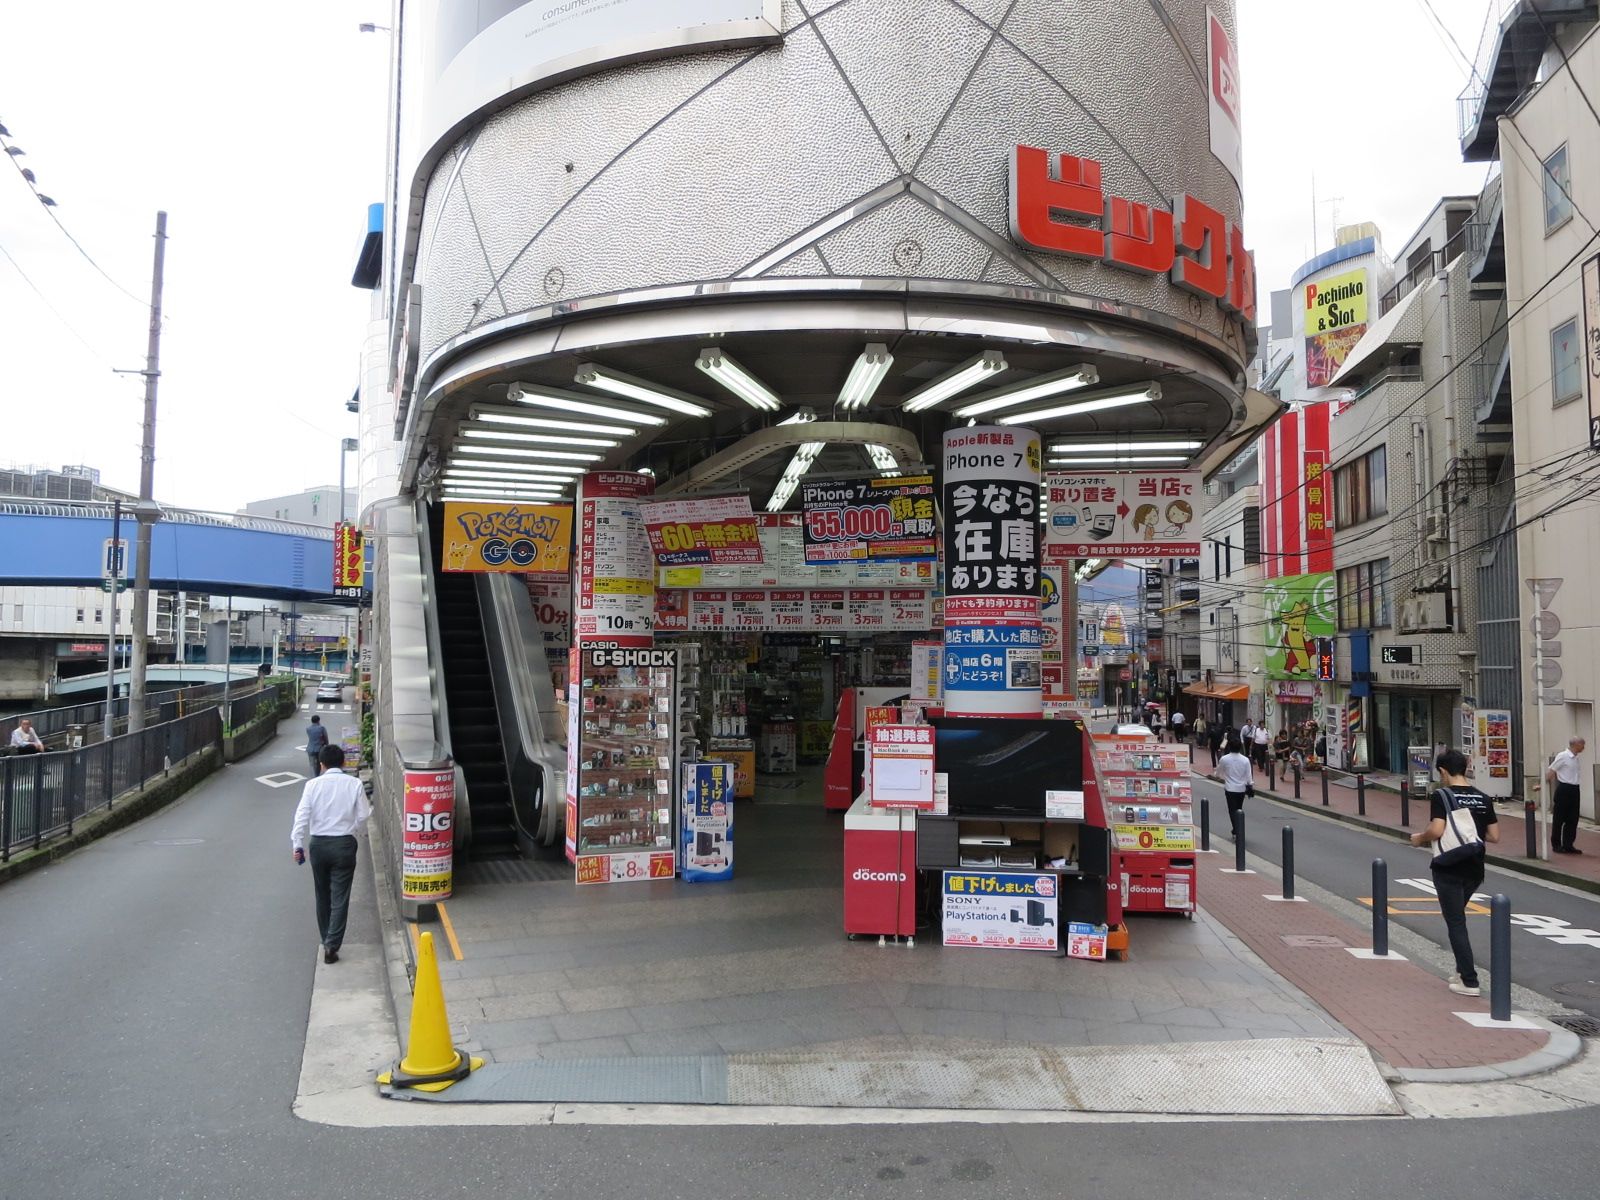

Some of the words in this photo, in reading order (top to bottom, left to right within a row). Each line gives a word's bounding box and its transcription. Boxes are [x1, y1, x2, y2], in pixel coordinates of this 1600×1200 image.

[1306, 281, 1363, 310] Pachinko
[1318, 317, 1327, 331] &
[1328, 303, 1355, 328] Slot
[946, 453, 1005, 471] iPhone
[1013, 453, 1024, 468] 7
[598, 474, 647, 486] ビックカメラ
[1138, 477, 1193, 497] 当店で
[804, 487, 854, 502] iPhone
[856, 485, 867, 499] 7
[952, 484, 1035, 518] 今なら
[1050, 487, 1117, 504] 取り置き
[1306, 462, 1324, 531] 接骨院
[893, 498, 934, 520] 現金
[584, 519, 592, 528] 5F
[584, 535, 592, 544] 4F
[954, 518, 1035, 562] 在庫
[481, 538, 537, 566] GO
[583, 551, 591, 559] 3F
[583, 566, 591, 574] 2F
[951, 563, 1038, 590] あります
[583, 582, 591, 591] 1F
[582, 598, 591, 606] B1
[581, 641, 618, 650] CASIO
[592, 650, 676, 666] G-SHOCK
[962, 671, 1003, 682] にどうぞ!
[712, 766, 723, 800] 値下げ
[701, 780, 709, 813] しました
[406, 812, 450, 832] BIG
[853, 871, 906, 882] docomo
[948, 876, 1034, 893] 値下げしました
[1130, 885, 1163, 893] docomo
[946, 897, 981, 905] SONY
